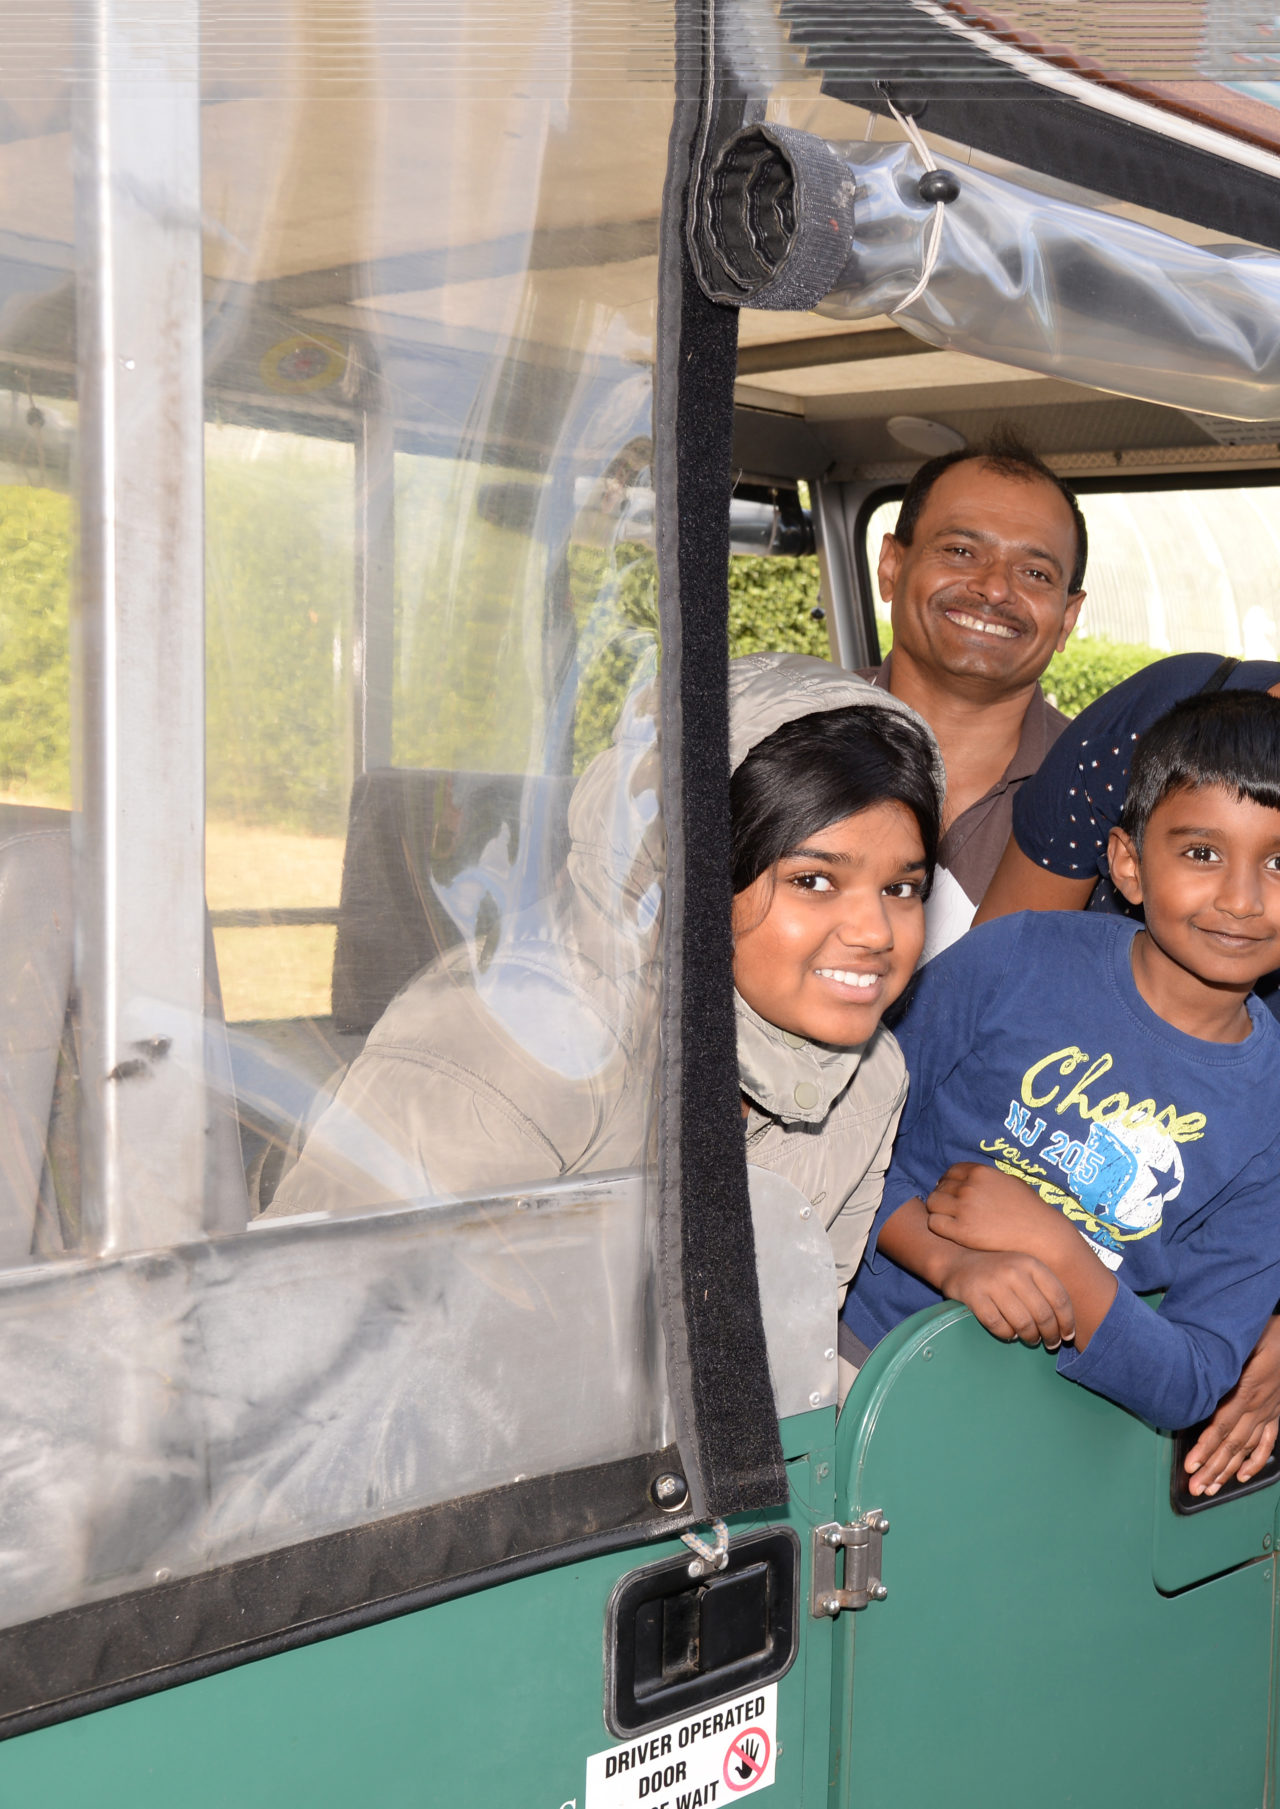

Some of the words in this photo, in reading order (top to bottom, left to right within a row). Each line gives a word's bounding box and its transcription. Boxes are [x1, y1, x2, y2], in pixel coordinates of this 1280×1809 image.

[1020, 1045, 1207, 1144] Choose
[979, 1137, 1048, 1176] your
[1004, 1099, 1048, 1148] NJ
[1040, 1129, 1106, 1185] 205
[605, 1733, 672, 1779] DRIVER
[678, 1695, 765, 1748] OPERATED
[638, 1760, 687, 1799] DOOR
[676, 1779, 719, 1809] WAIT
